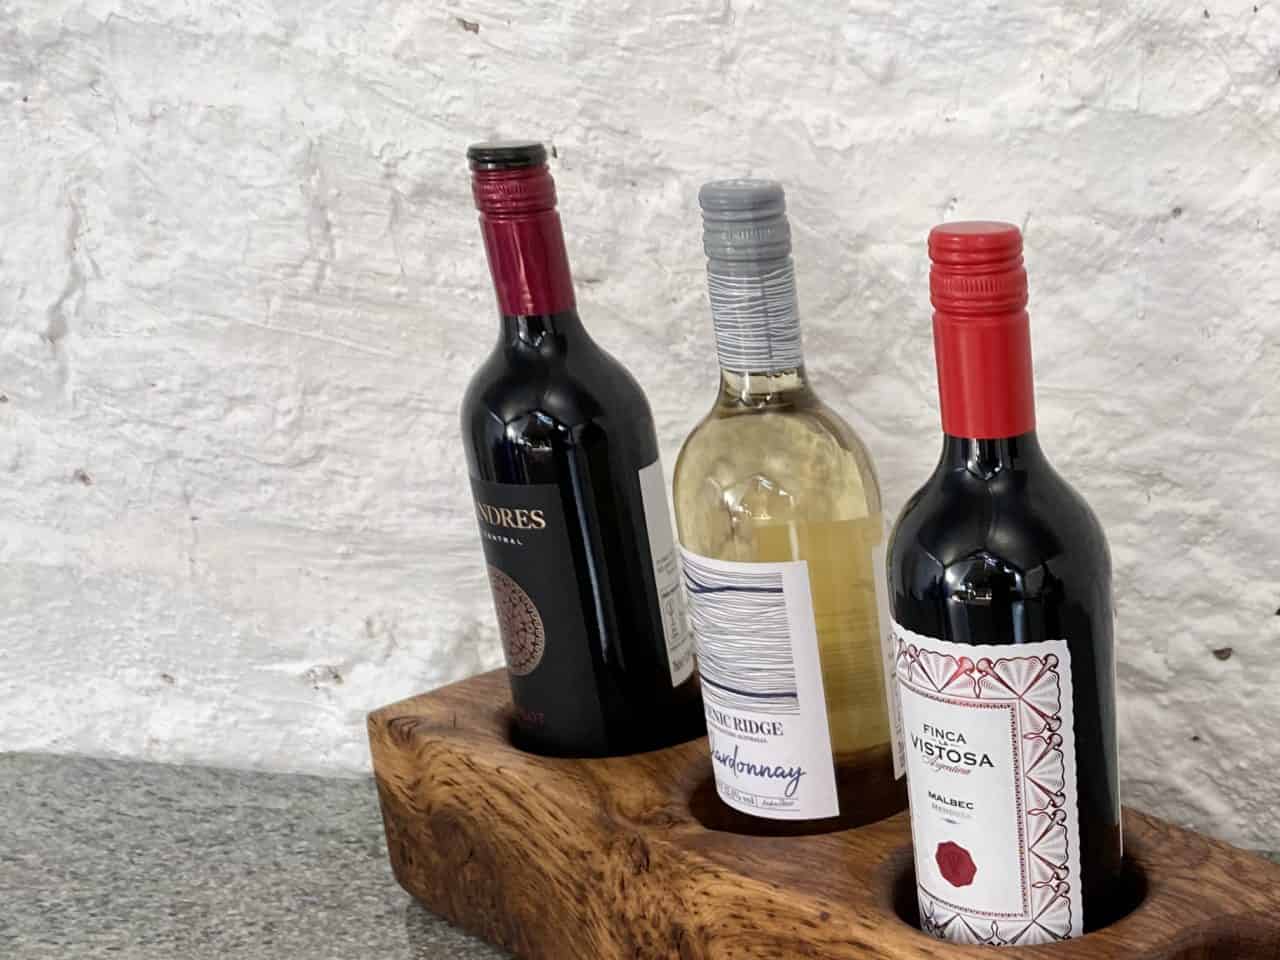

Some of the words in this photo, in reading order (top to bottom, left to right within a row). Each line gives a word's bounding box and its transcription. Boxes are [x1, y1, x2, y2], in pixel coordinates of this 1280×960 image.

[729, 716, 785, 737] RIDGE
[923, 722, 968, 745] FINCA
[910, 730, 995, 768] VISTOSA
[928, 789, 975, 810] MALBEC
